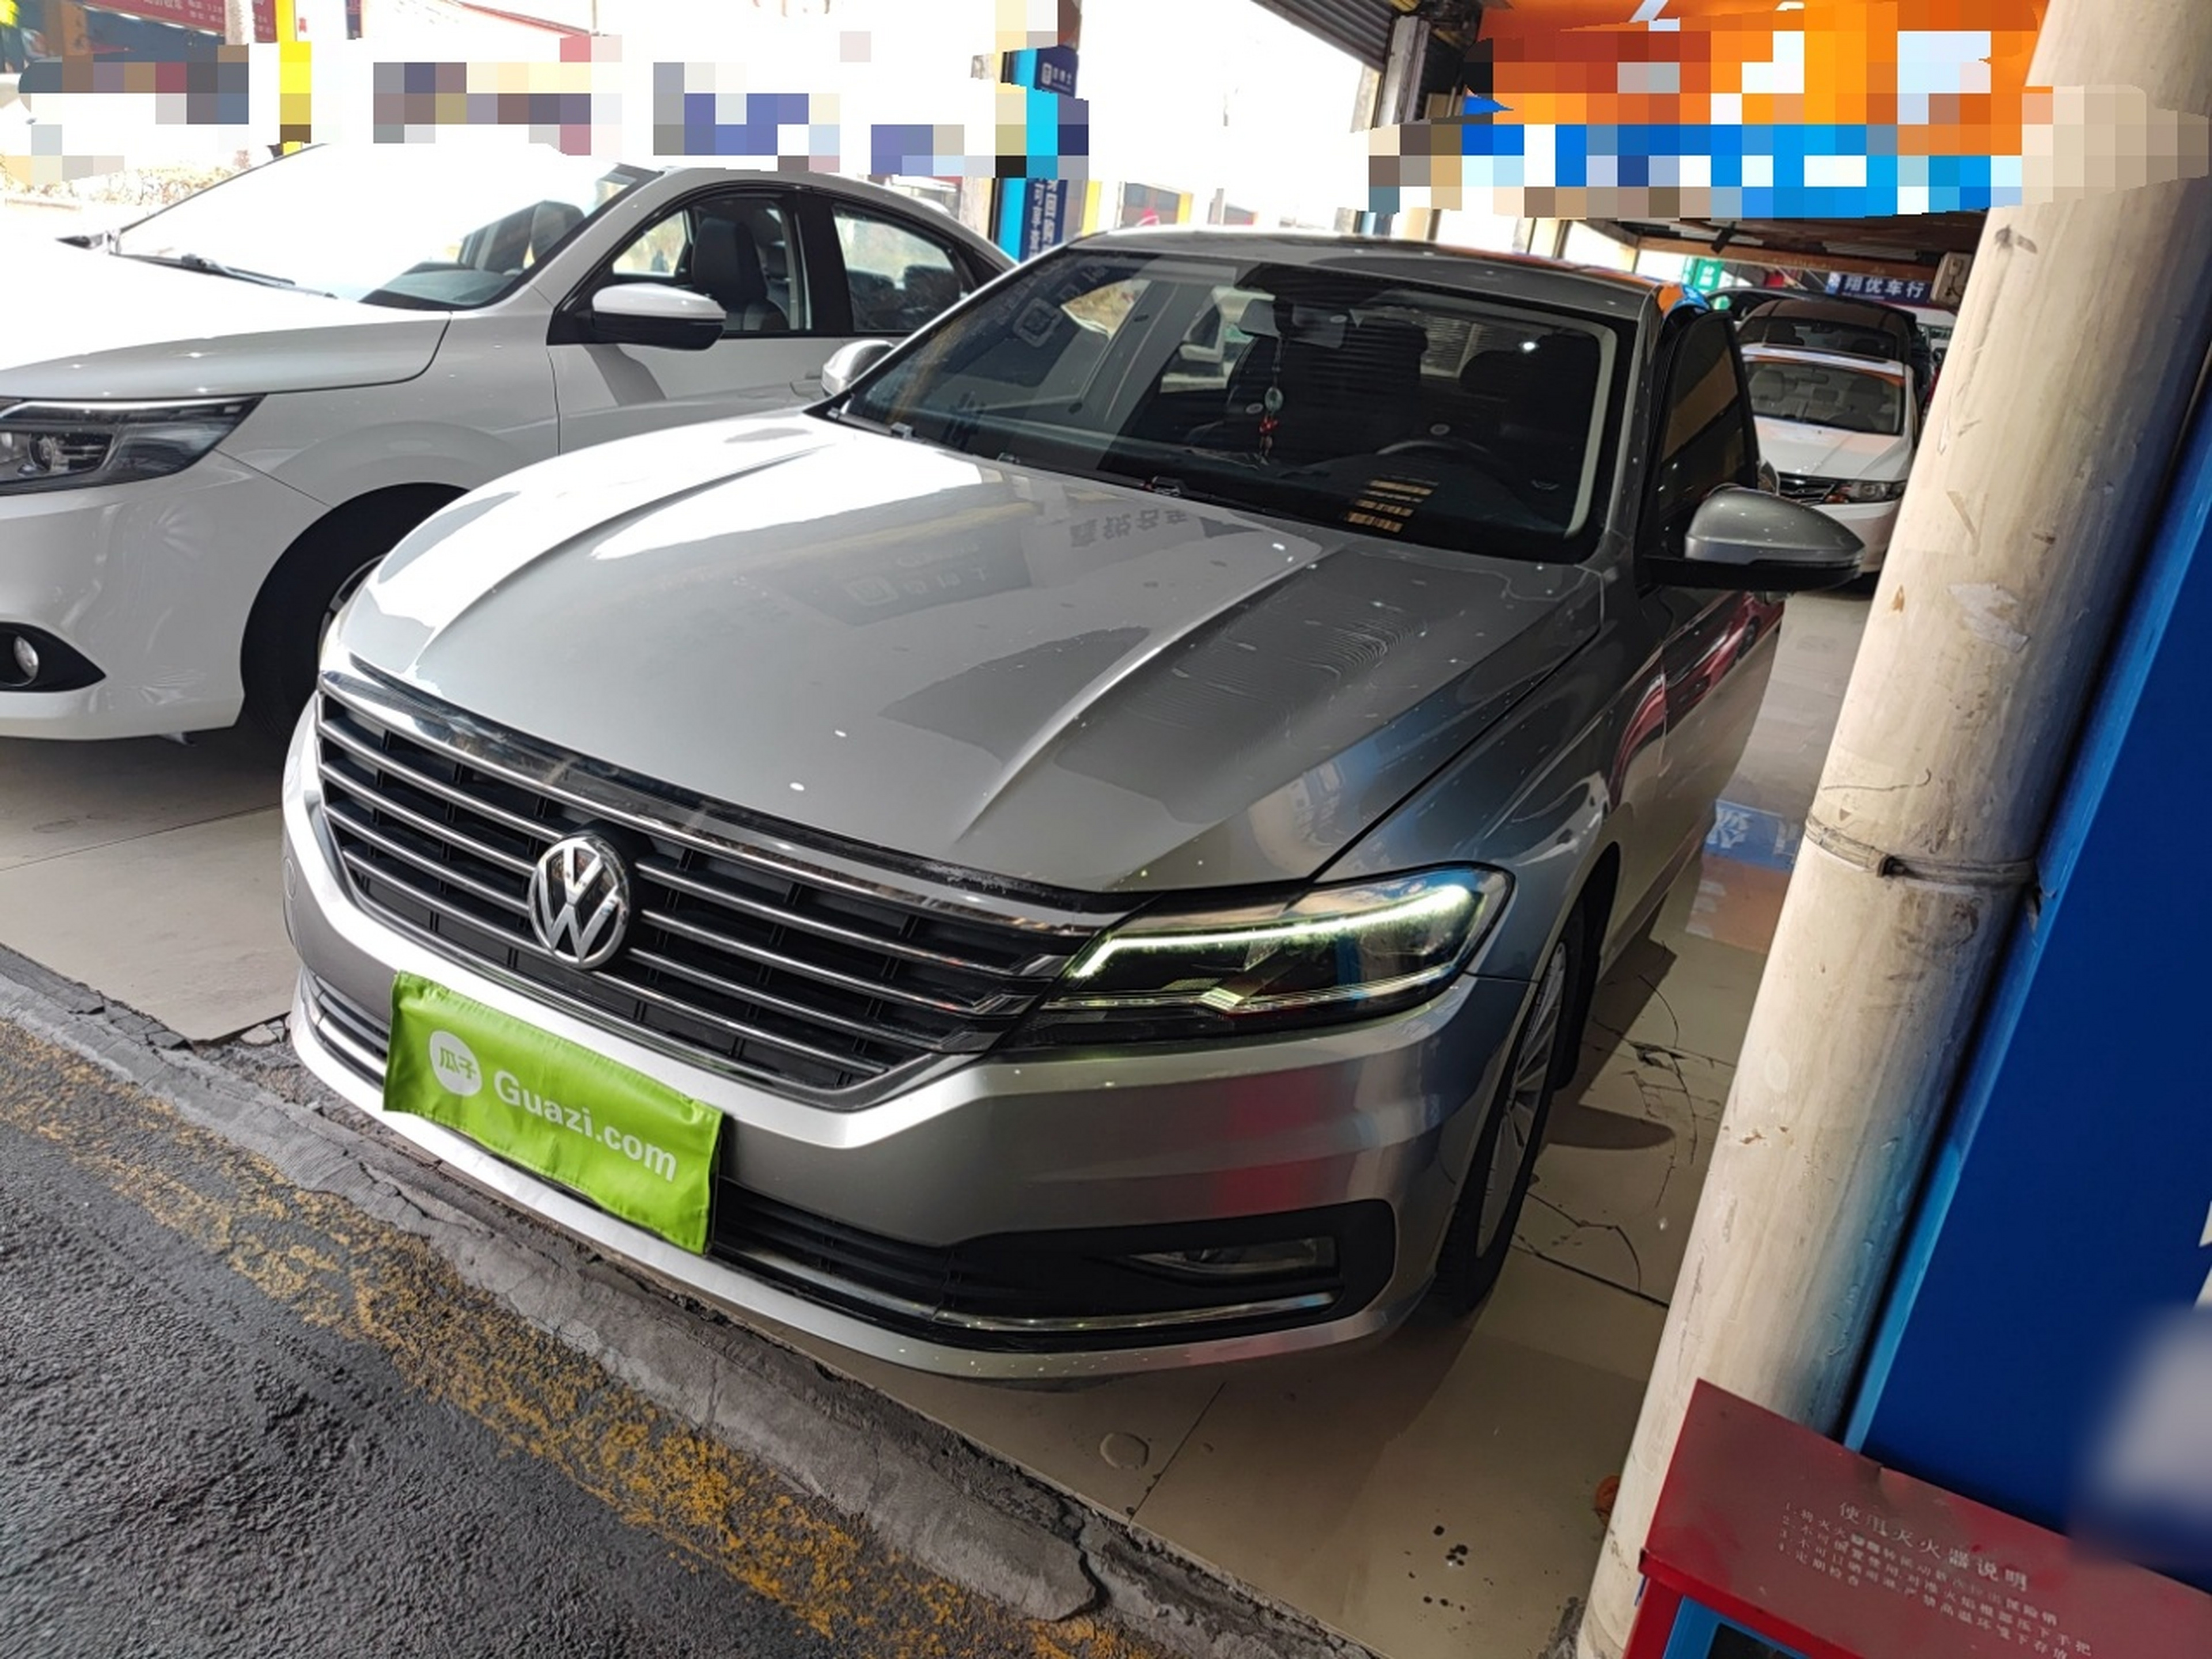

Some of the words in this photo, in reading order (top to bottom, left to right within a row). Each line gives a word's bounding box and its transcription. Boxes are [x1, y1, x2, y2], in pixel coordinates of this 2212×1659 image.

[440, 1047, 477, 1080] 瓜子
[494, 1070, 677, 1183] Guazi.com
[1839, 1502, 2028, 1592] 使用灭火器说明
